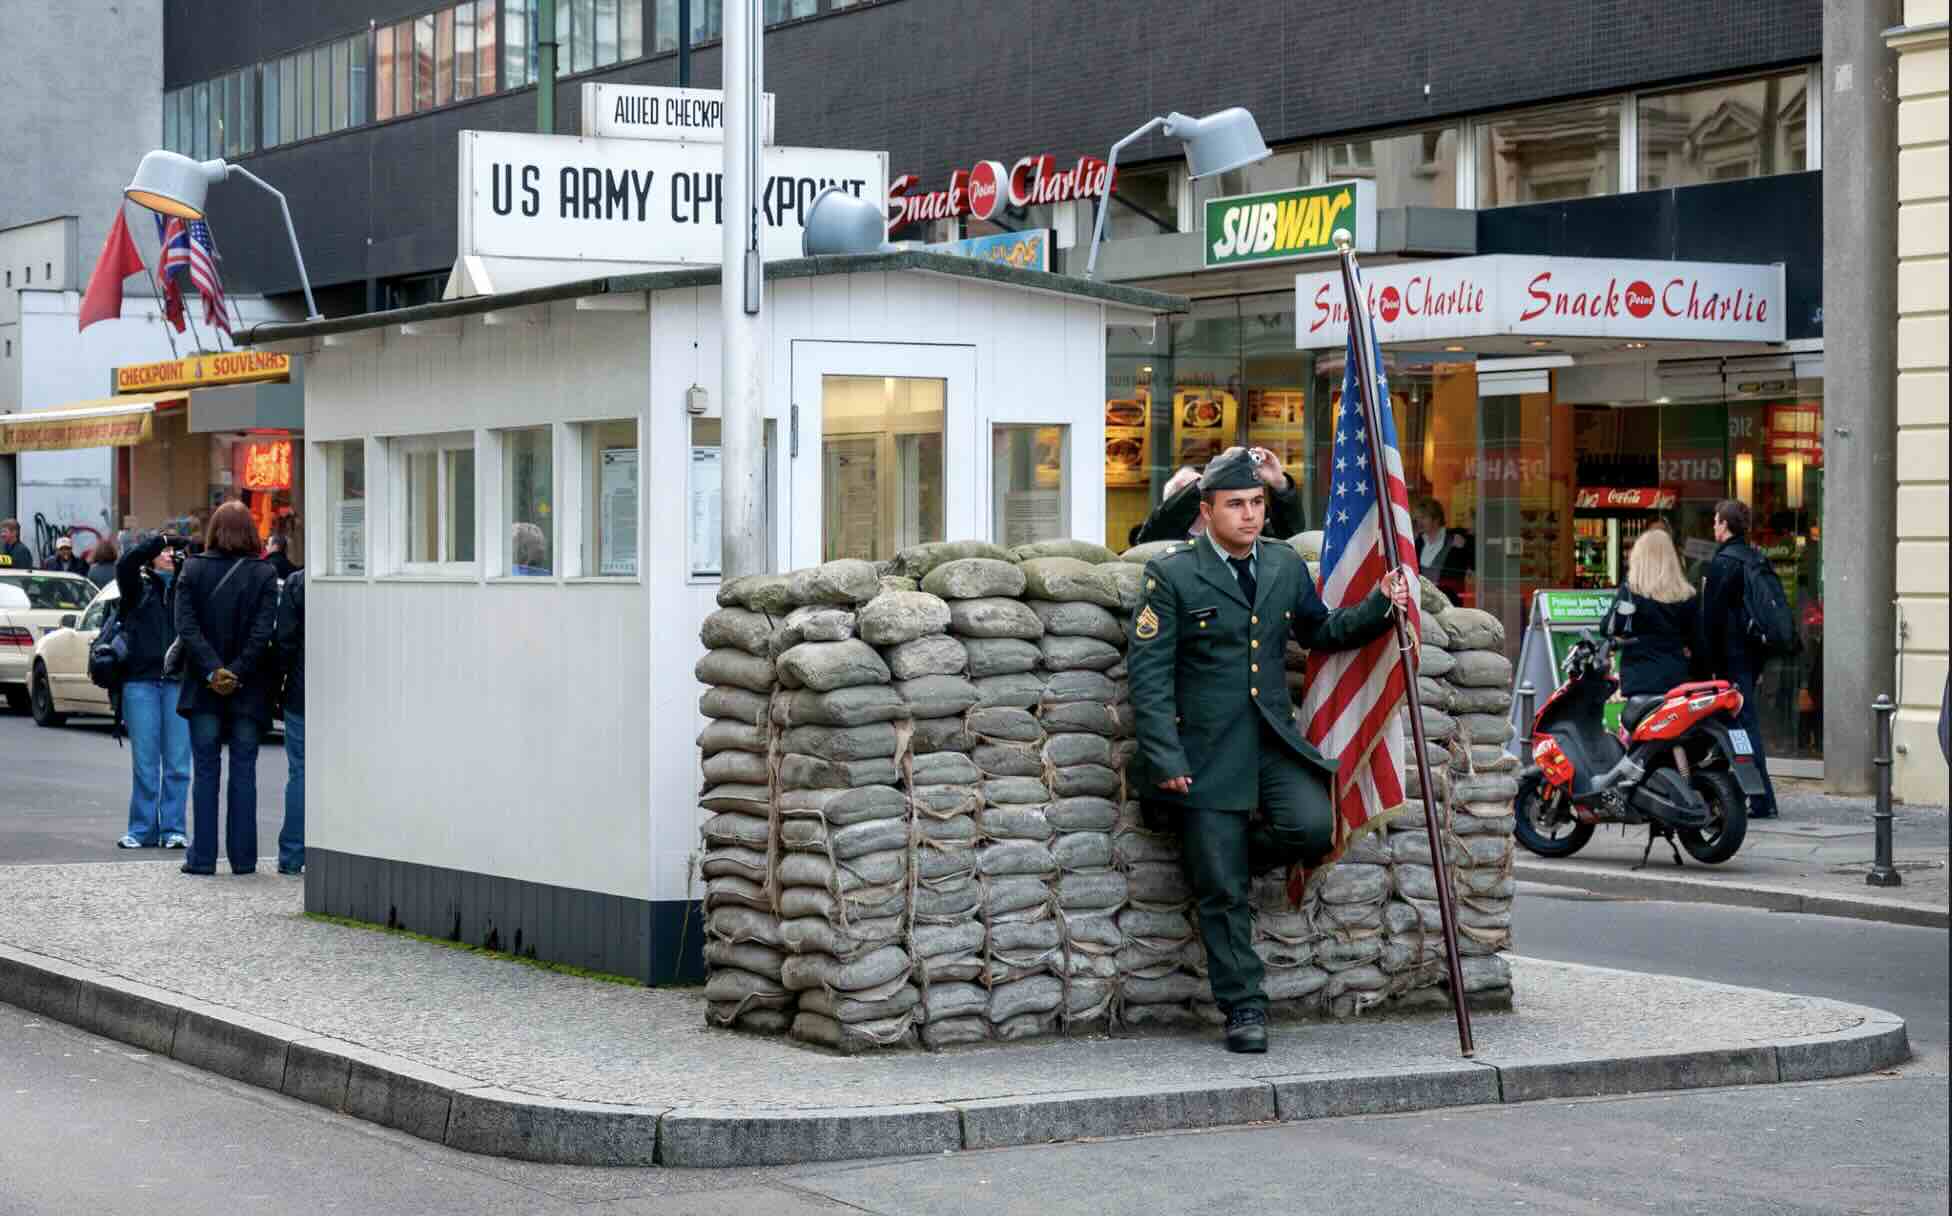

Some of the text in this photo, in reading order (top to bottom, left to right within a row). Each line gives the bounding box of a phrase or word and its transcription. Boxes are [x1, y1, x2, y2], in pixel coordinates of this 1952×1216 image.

[614, 95, 723, 128] ALLIED CHECKP
[559, 166, 654, 222] ARMY
[888, 169, 962, 229] Snack
[1214, 188, 1352, 260] SUBWAY
[1405, 276, 1485, 317] Charlie
[1520, 271, 1619, 322] Snack
[1627, 291, 1654, 307] Point
[1662, 279, 1767, 323] Charlie
[119, 362, 185, 387] CHECKPOINT
